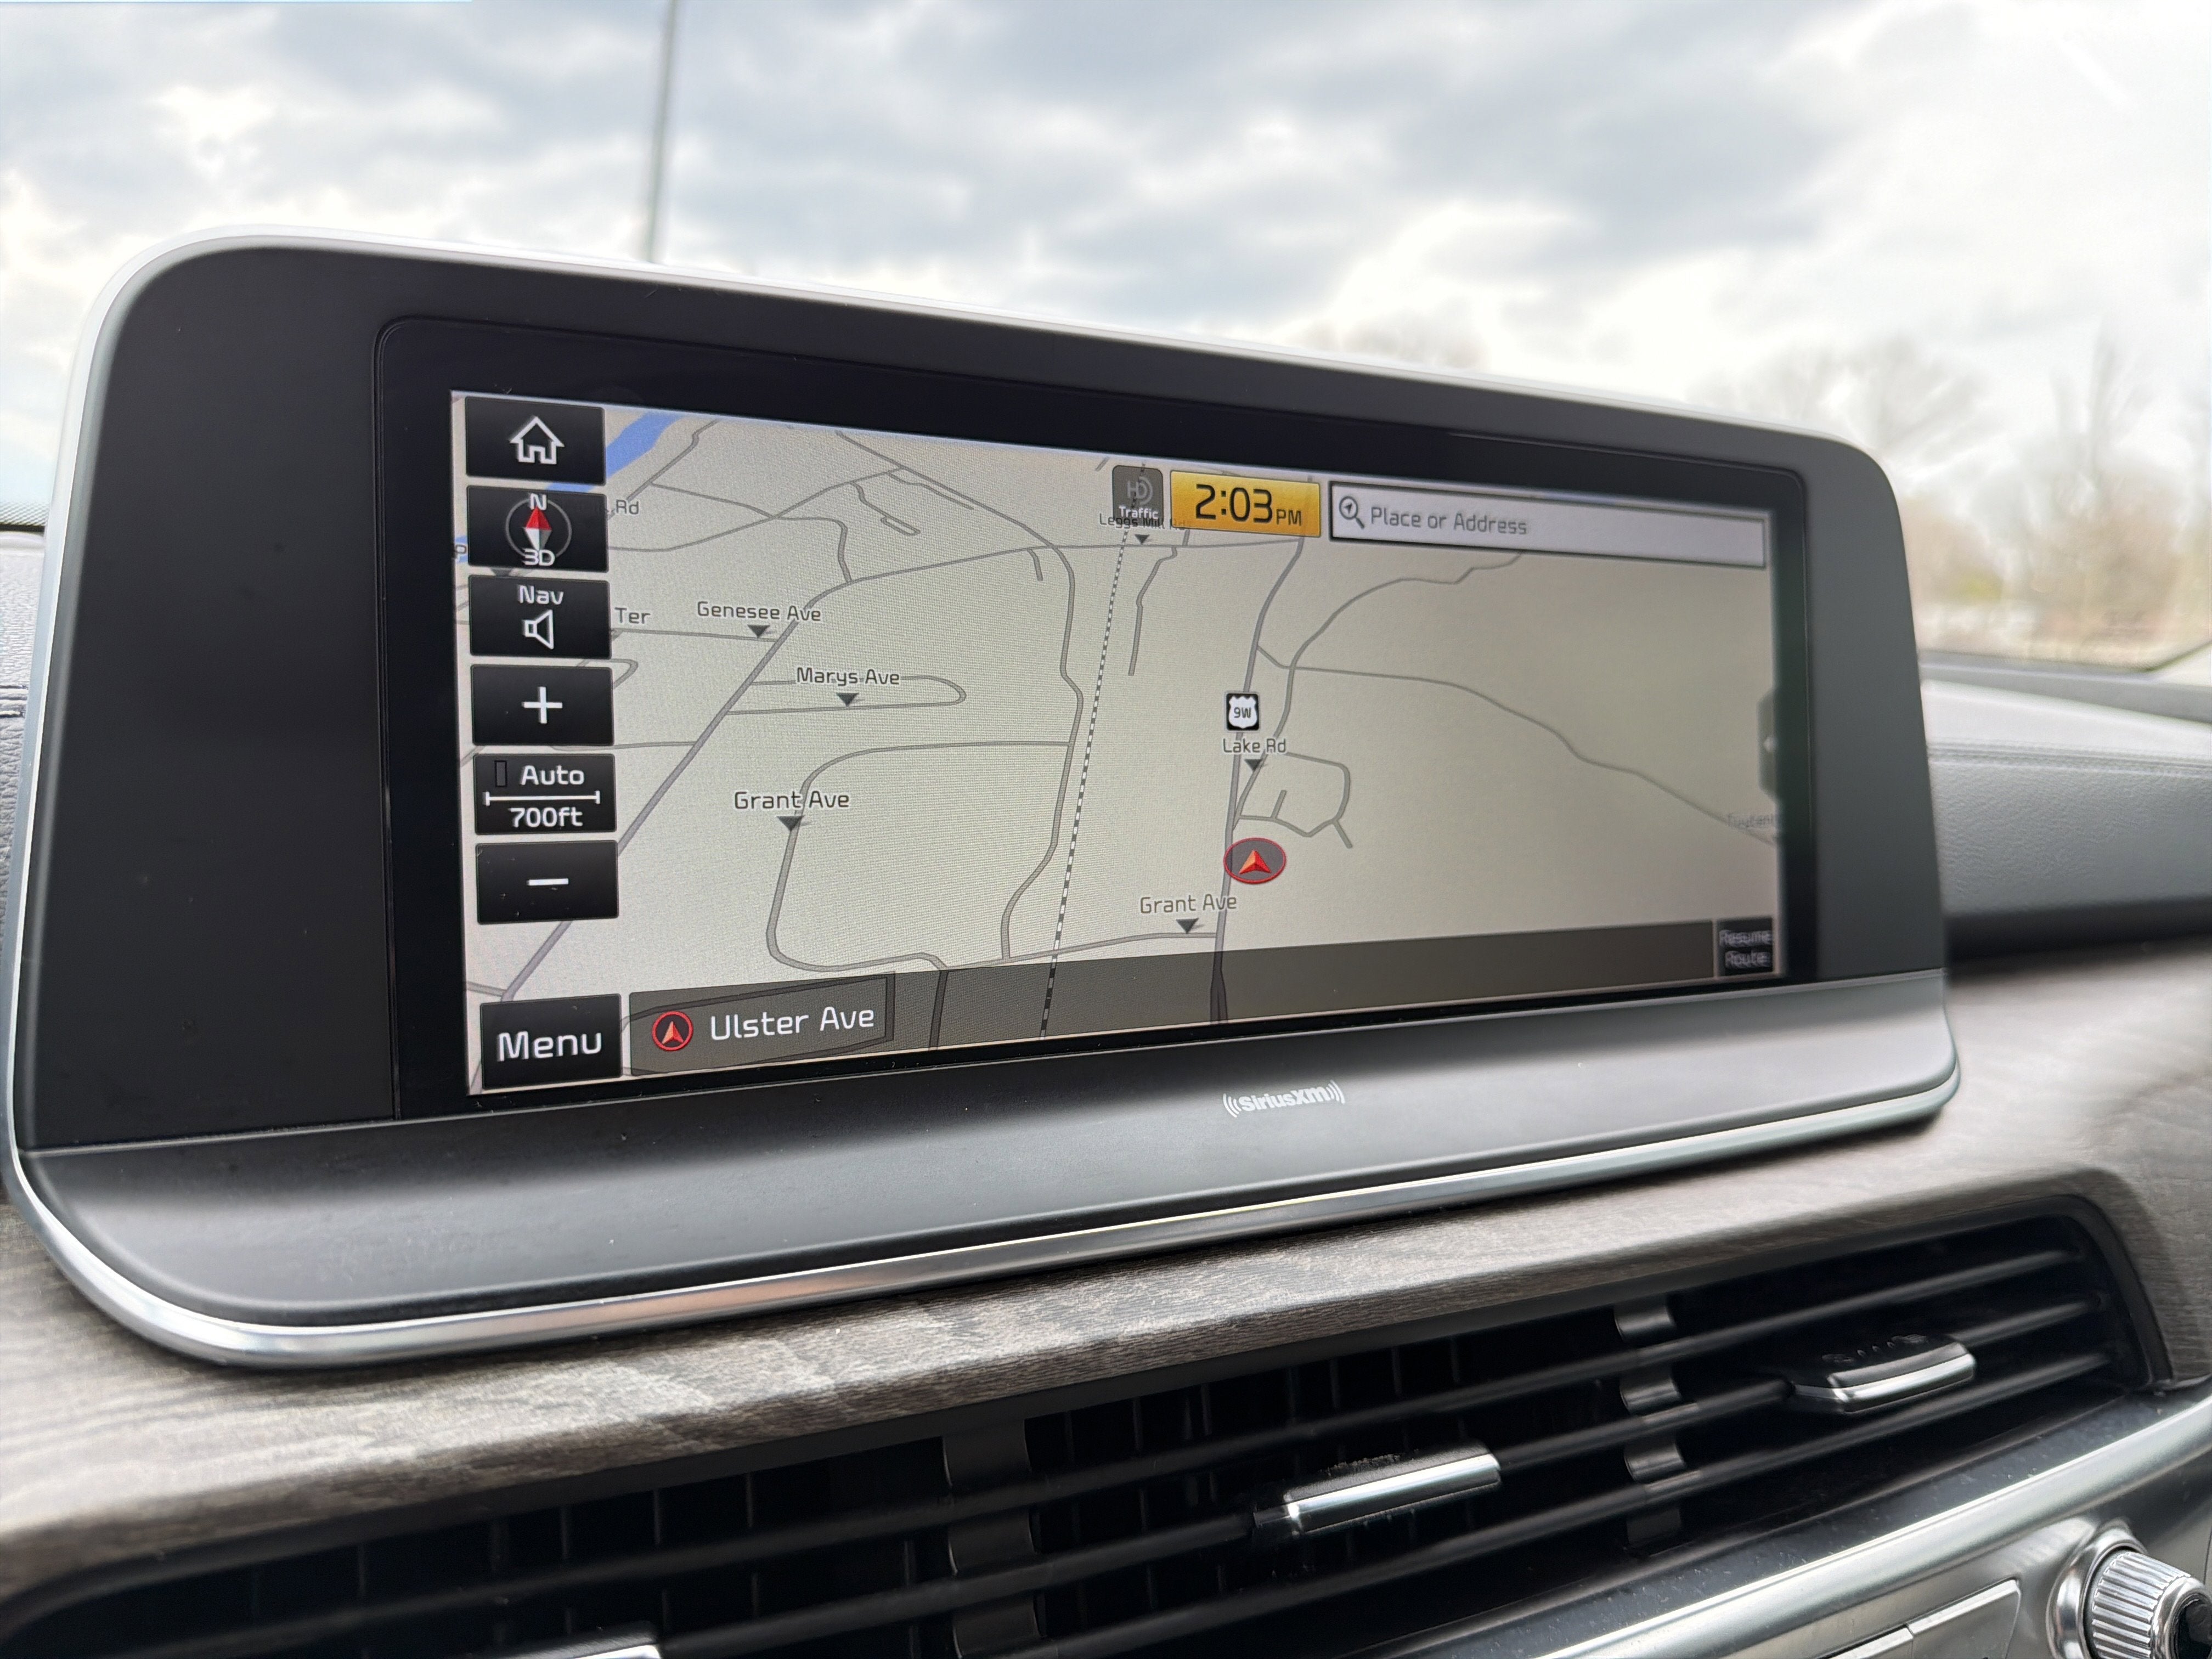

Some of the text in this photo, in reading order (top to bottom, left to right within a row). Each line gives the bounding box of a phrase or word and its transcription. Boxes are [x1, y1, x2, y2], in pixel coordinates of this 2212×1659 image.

[1118, 506, 1159, 520] Traffic
[1370, 507, 1527, 535] Place or Address
[523, 549, 555, 566] 3D
[518, 585, 563, 605] Nav
[615, 607, 651, 624] Ter
[697, 601, 821, 622] Genesee Ave
[796, 666, 900, 686] Marys Ave
[1233, 707, 1251, 718] 9W
[1223, 738, 1286, 753] Lake Rd
[521, 766, 585, 786] Auto
[733, 791, 850, 810] Grant Ave
[511, 806, 583, 827] 700ft
[1140, 894, 1238, 915] Grant Ave
[1725, 950, 1770, 969] Route
[710, 1006, 875, 1042] Ulster Ave
[496, 1031, 603, 1062] Menu
